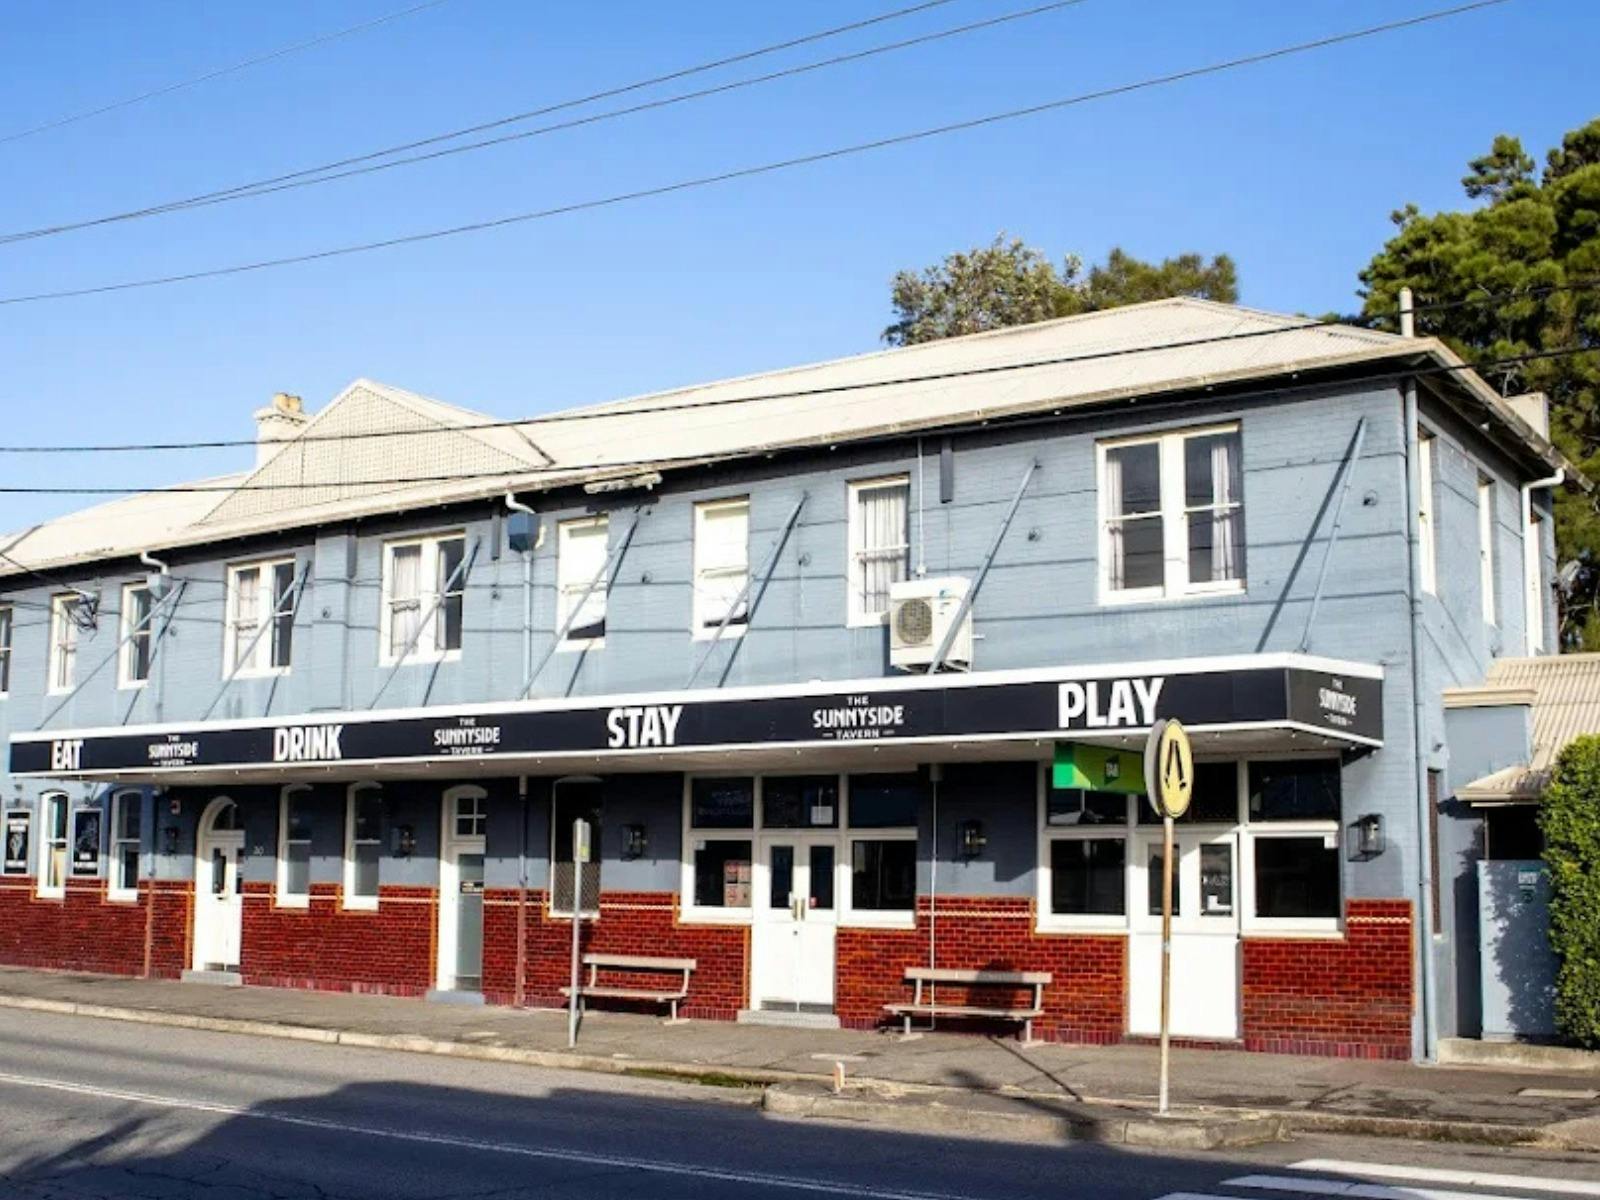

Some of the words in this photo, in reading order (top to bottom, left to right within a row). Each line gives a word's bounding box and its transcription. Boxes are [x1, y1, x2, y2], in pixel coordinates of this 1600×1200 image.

[847, 695, 869, 706] THE
[1058, 678, 1165, 728] PLAY
[606, 705, 684, 747] STAY
[812, 705, 904, 728] SUNNYSIDE
[274, 725, 344, 761] DRINK
[433, 726, 501, 746] SUNNYSIDE
[836, 728, 880, 740] TAVERN
[51, 739, 84, 770] EAT
[148, 741, 199, 759] SUNNYSIDE
